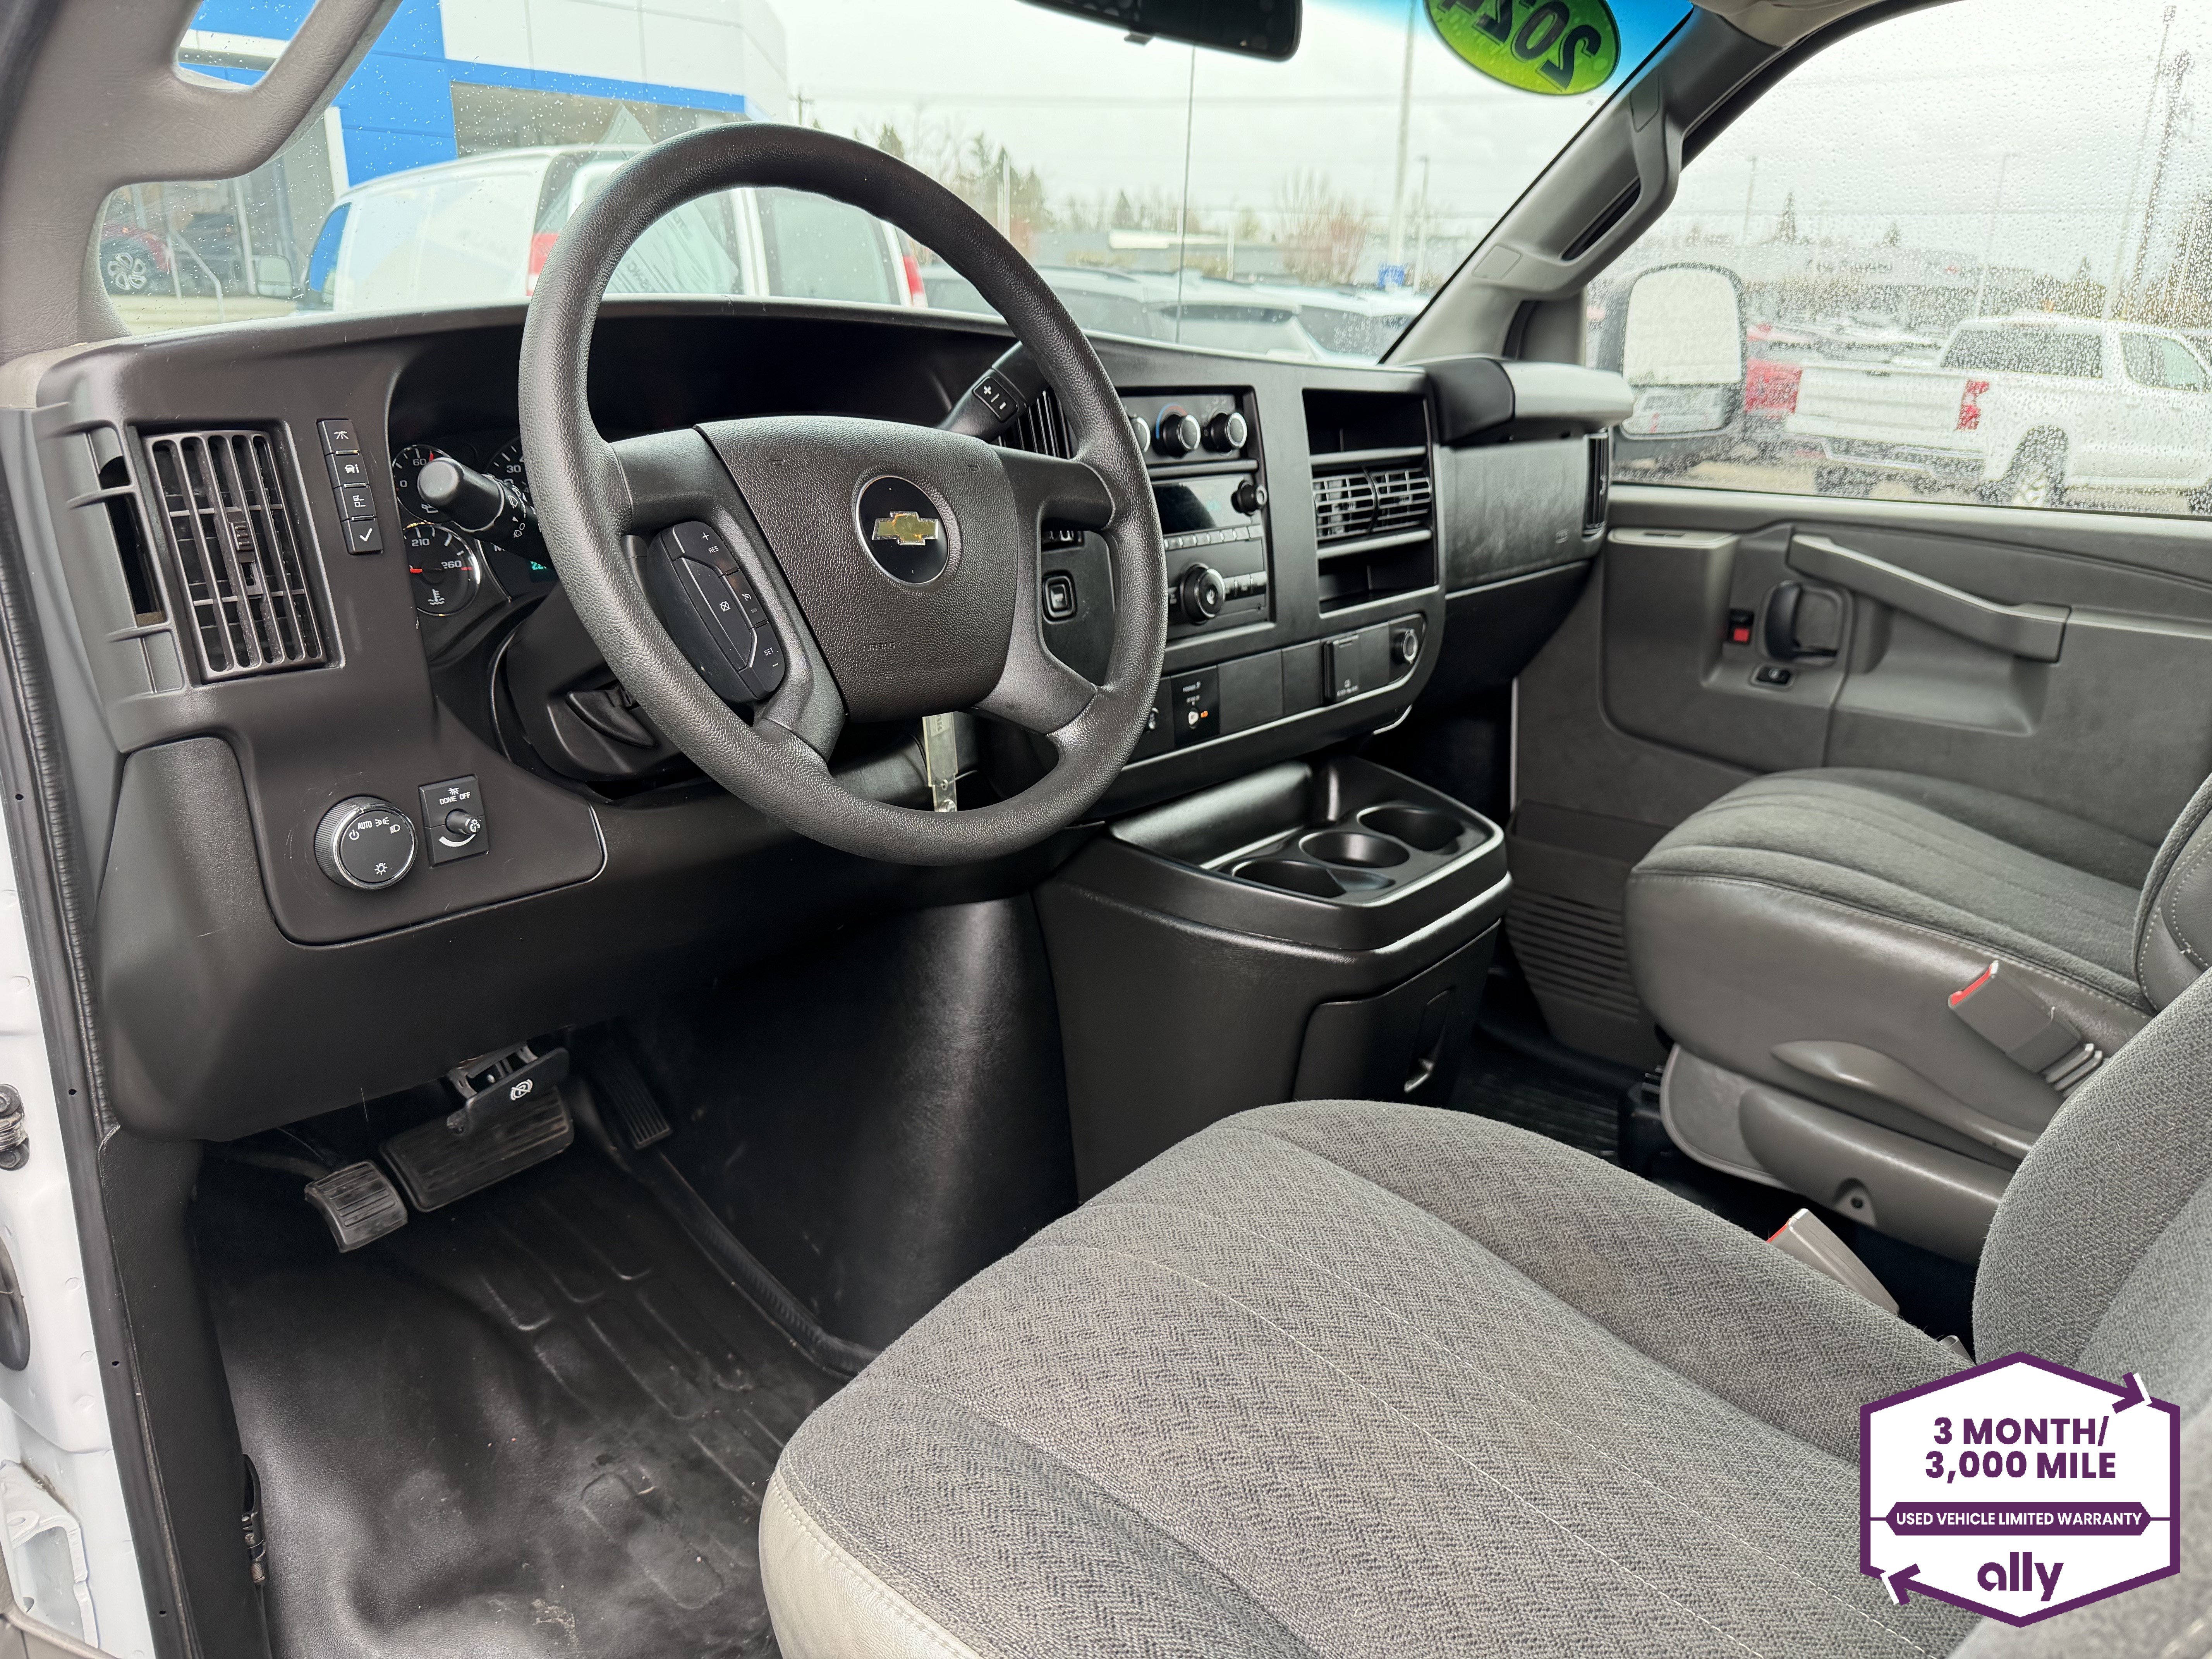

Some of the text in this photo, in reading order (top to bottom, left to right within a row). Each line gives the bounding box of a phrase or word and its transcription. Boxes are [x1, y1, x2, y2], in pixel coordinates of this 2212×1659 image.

[506, 465, 522, 473] 30
[411, 538, 430, 547] 210
[441, 560, 462, 569] 260
[764, 647, 773, 656] SET
[440, 792, 471, 805] DOME OFF
[358, 820, 372, 830] AUTO
